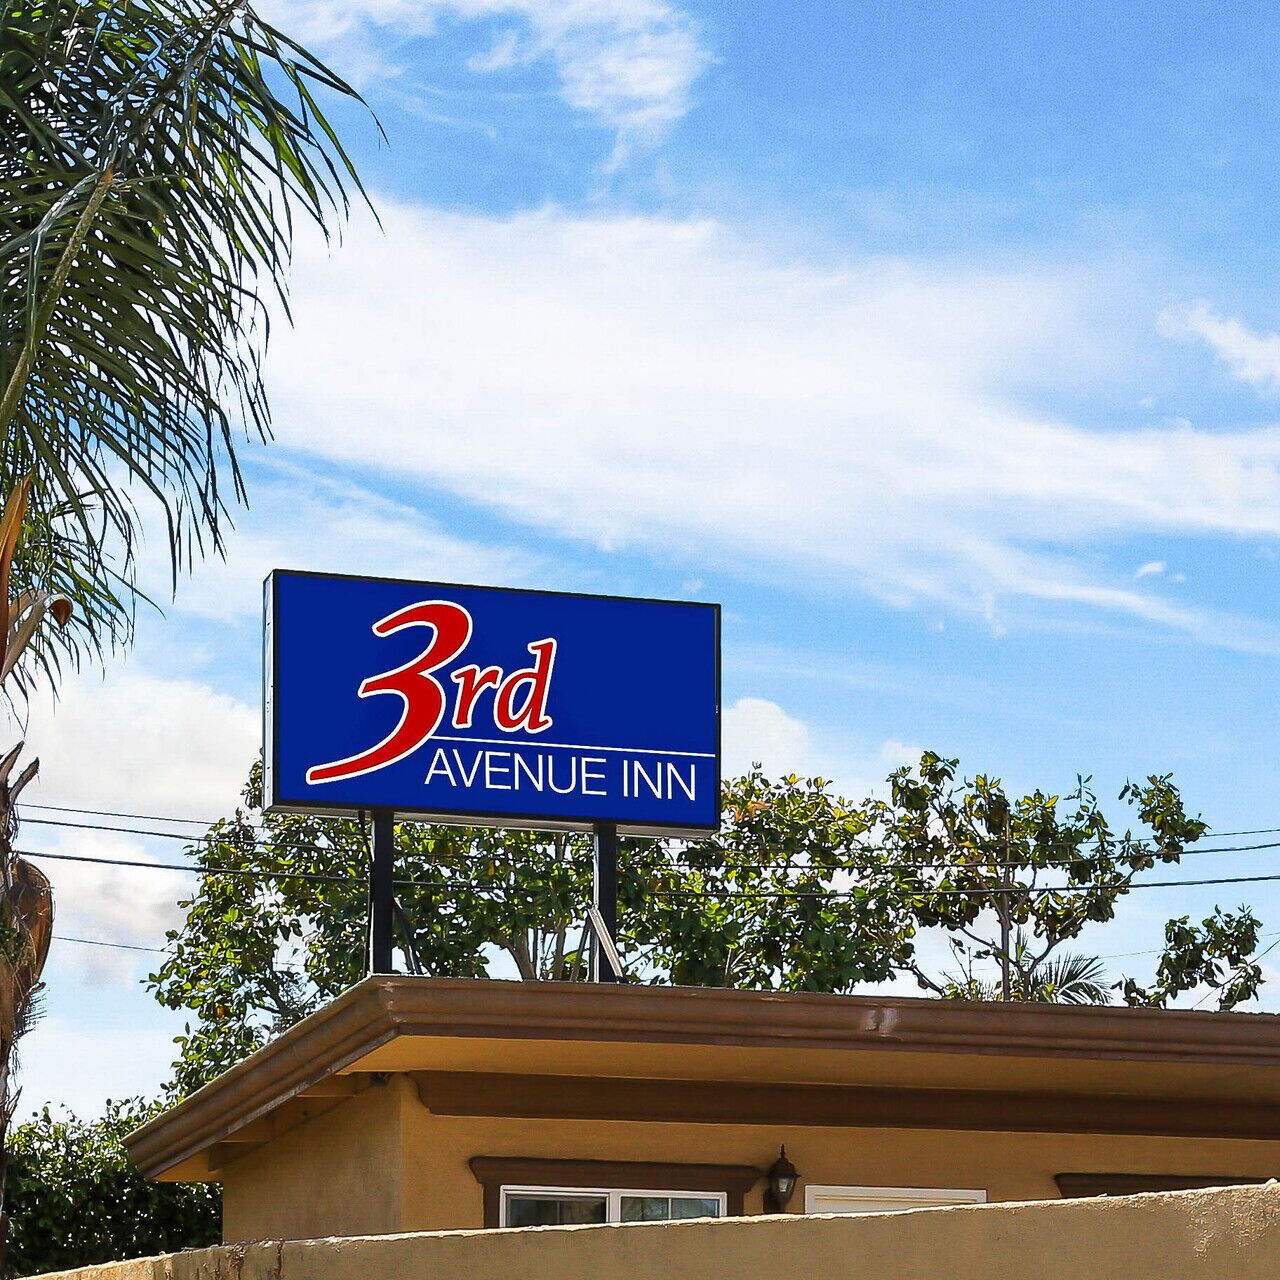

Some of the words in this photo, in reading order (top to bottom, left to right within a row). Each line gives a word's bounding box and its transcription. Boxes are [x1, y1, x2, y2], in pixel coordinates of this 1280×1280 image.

[305, 599, 558, 786] 3rd
[424, 747, 608, 797] AVENUE
[622, 759, 697, 802] INN
